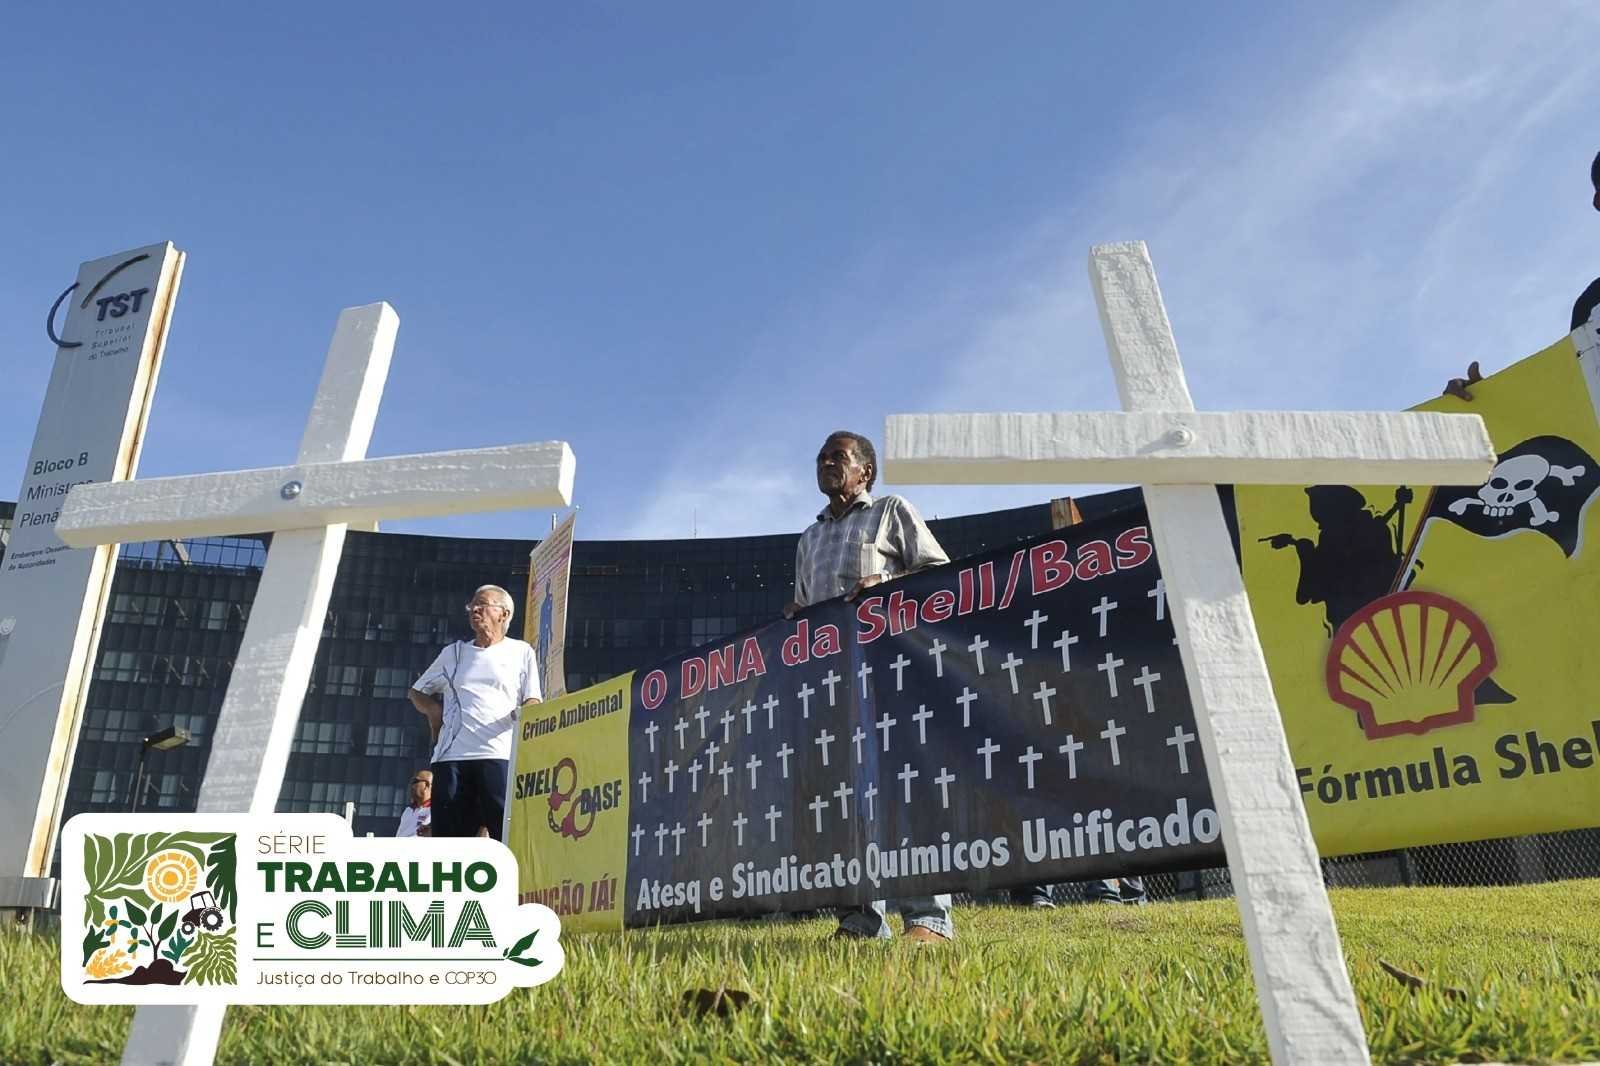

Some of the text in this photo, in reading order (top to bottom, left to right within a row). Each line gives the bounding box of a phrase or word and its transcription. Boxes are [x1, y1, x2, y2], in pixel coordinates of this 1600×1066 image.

[96, 288, 149, 322] TST
[33, 452, 89, 476] Bloco B
[26, 479, 94, 502] Minist
[20, 506, 61, 529] Plená
[641, 526, 1153, 710] O DNA da Shell/Bas
[523, 689, 623, 741] Crime Ambiental
[1295, 746, 1482, 804] Fórmula
[580, 779, 622, 816] BASF
[637, 878, 701, 914] Atesq
[709, 876, 723, 901] e
[732, 854, 861, 899] Sindicato
[866, 831, 1010, 889] Químicos
[588, 872, 618, 912] JÁ!
